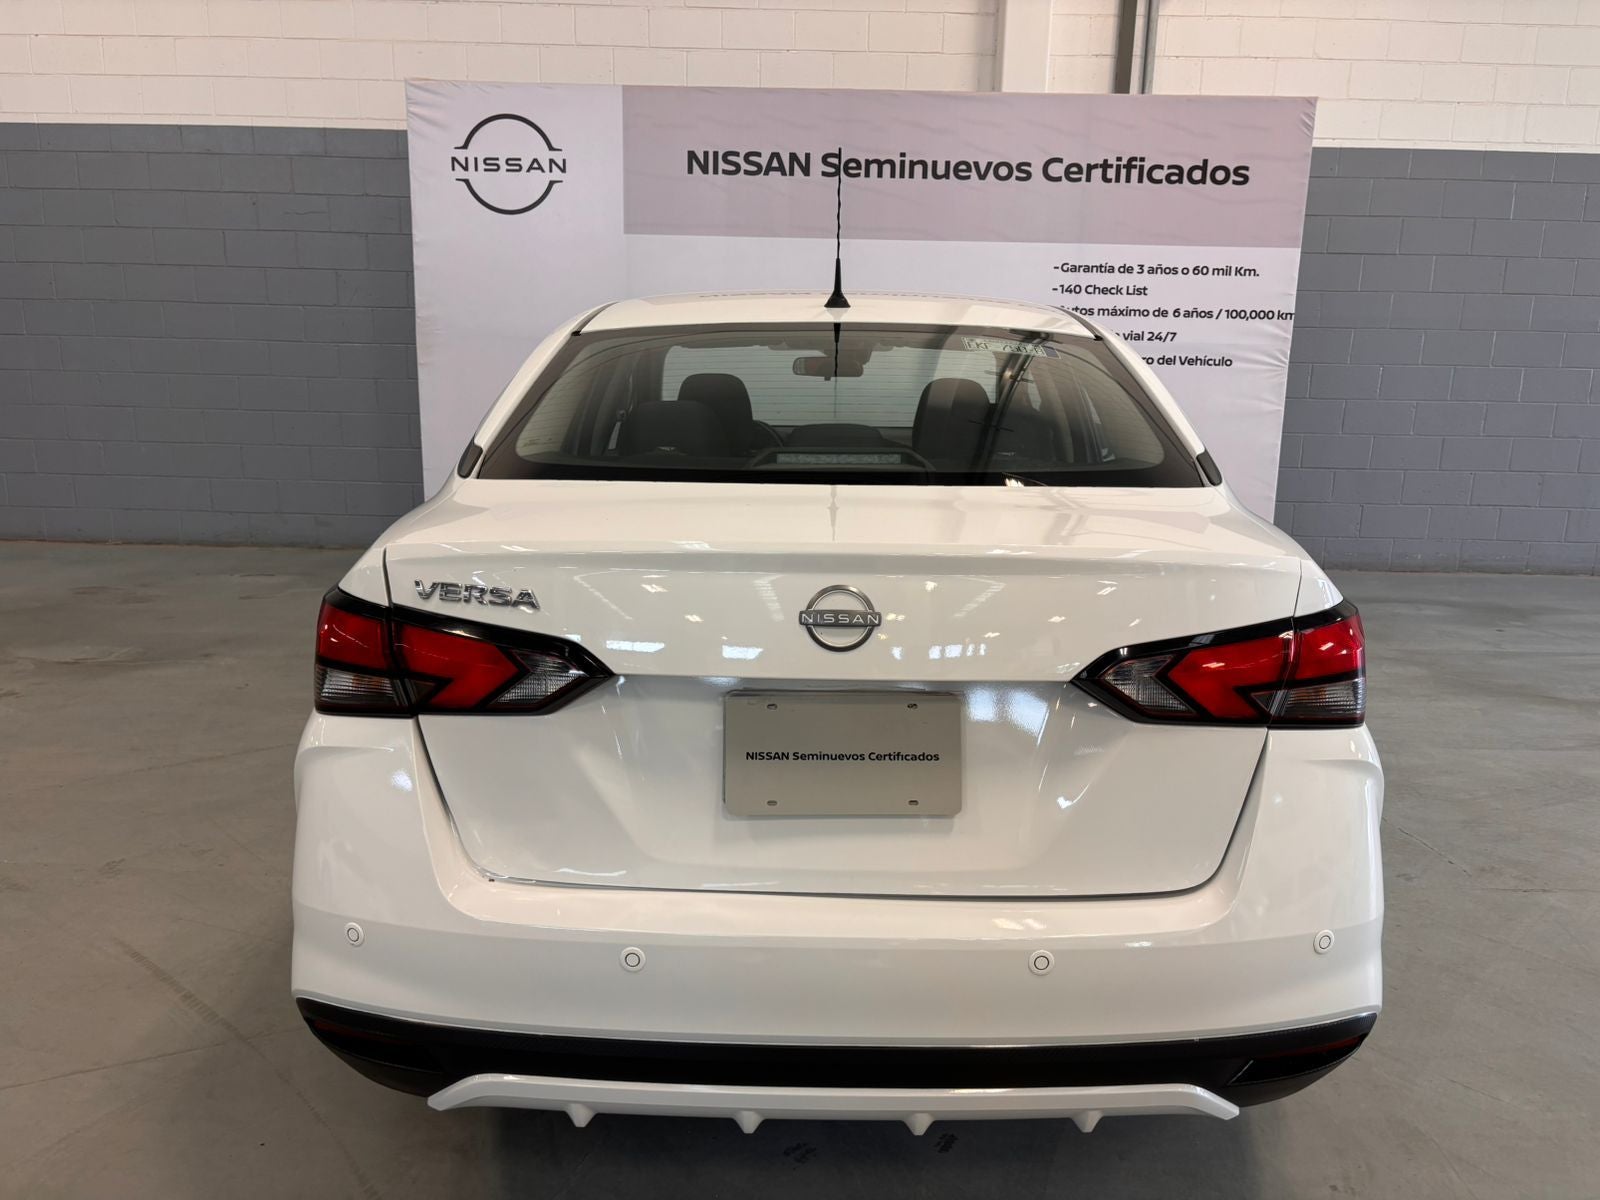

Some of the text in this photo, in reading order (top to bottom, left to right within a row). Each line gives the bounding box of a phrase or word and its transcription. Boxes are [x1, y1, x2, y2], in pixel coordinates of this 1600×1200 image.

[451, 156, 567, 174] NISSAN
[687, 150, 1250, 186] NISSAN Seminuevos Certificados
[1117, 263, 1134, 274] de
[1136, 264, 1145, 275] 3
[1147, 264, 1179, 275] años
[1181, 266, 1190, 276] o
[1192, 265, 1210, 276] 60
[1212, 265, 1232, 277] mil
[1234, 266, 1260, 277] Km.
[1084, 284, 1124, 296] Check
[1126, 285, 1148, 296] List
[1097, 305, 1150, 317] máximo
[1152, 306, 1169, 318] de
[1172, 307, 1181, 318] 6
[1182, 307, 1214, 319] años
[1215, 308, 1223, 320] /
[1224, 309, 1275, 321] 100,000
[1122, 330, 1145, 341] vial
[1146, 331, 1177, 342] 24/7
[1156, 355, 1177, 366] del
[1178, 356, 1233, 367] Vehículo
[414, 579, 541, 610] VERSA
[801, 613, 880, 625] NISSAN
[745, 751, 940, 762] NISSAN Seminuevos Certificados
